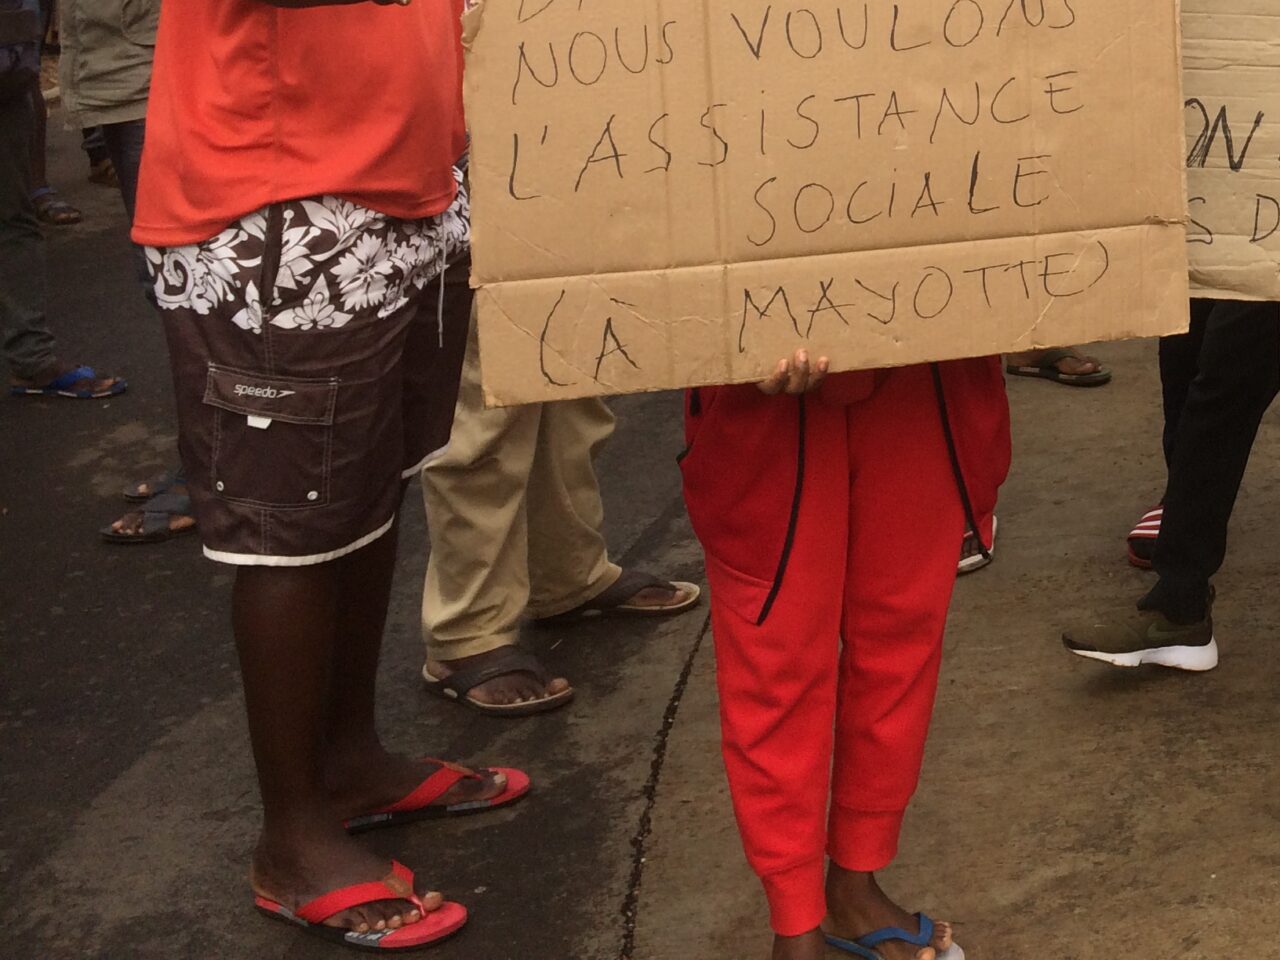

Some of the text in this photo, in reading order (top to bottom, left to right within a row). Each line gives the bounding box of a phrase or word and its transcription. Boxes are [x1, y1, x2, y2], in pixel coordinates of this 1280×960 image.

[511, 20, 677, 106] NOUS
[507, 71, 1086, 202] L'ASSISTANCE
[747, 150, 1053, 247] SOCIALE
[738, 240, 1111, 353] MAYOTTE)
[233, 383, 278, 399] speedo
